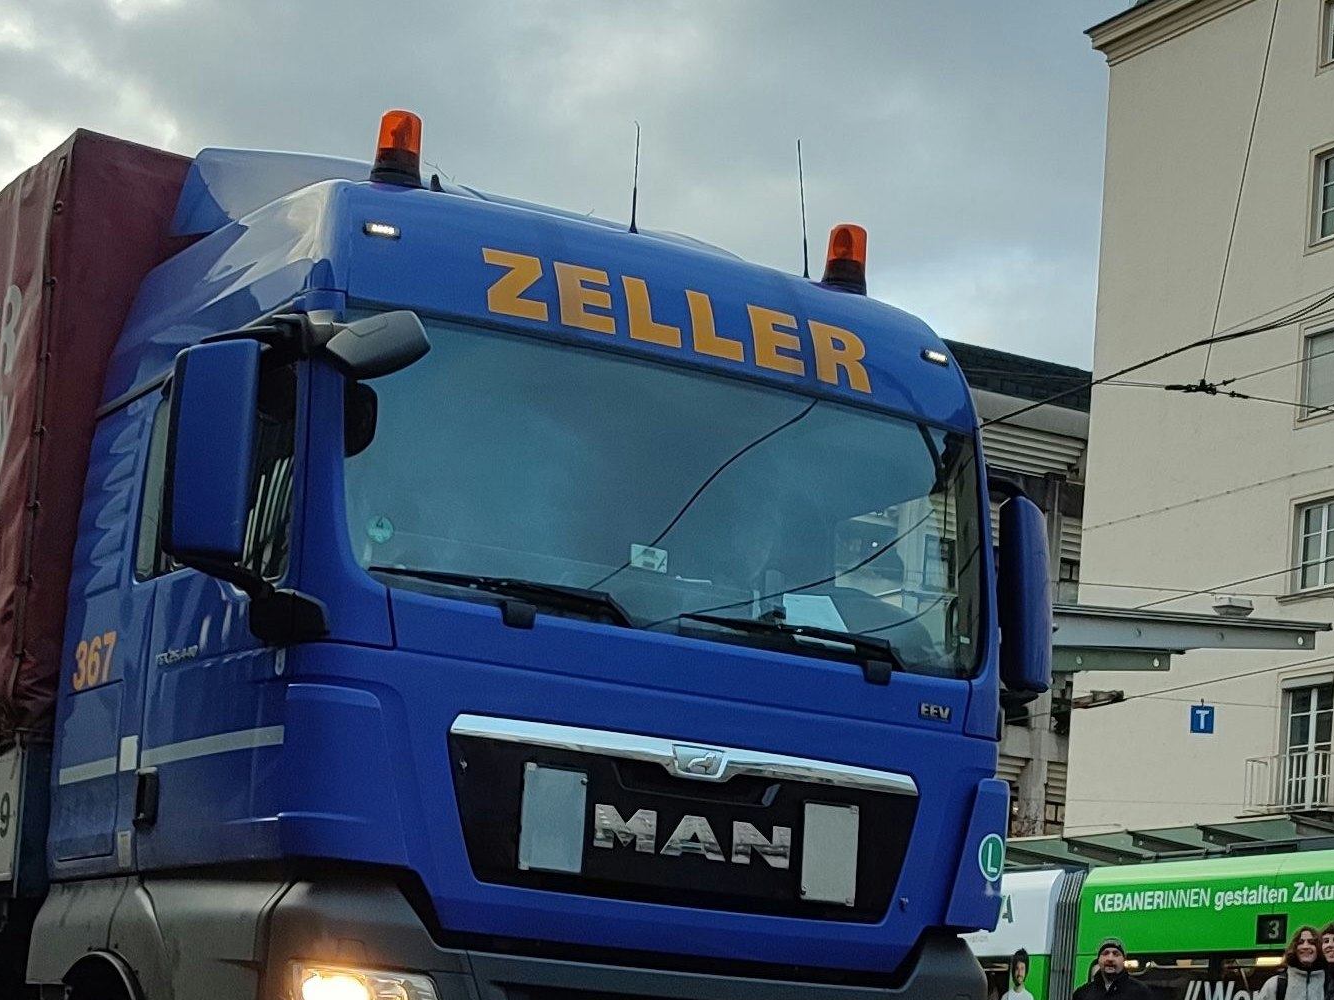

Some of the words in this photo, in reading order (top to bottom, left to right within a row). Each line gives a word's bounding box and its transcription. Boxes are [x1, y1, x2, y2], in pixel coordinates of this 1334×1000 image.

[482, 247, 873, 394] ZELLER
[73, 631, 117, 691] 367
[920, 703, 950, 719] EEV
[1196, 710, 1210, 730] T
[593, 803, 792, 870] MAN
[987, 842, 998, 873] L
[1094, 888, 1212, 913] KEBANERINNEN
[1214, 883, 1288, 911] gestalten
[1268, 920, 1280, 939] 3
